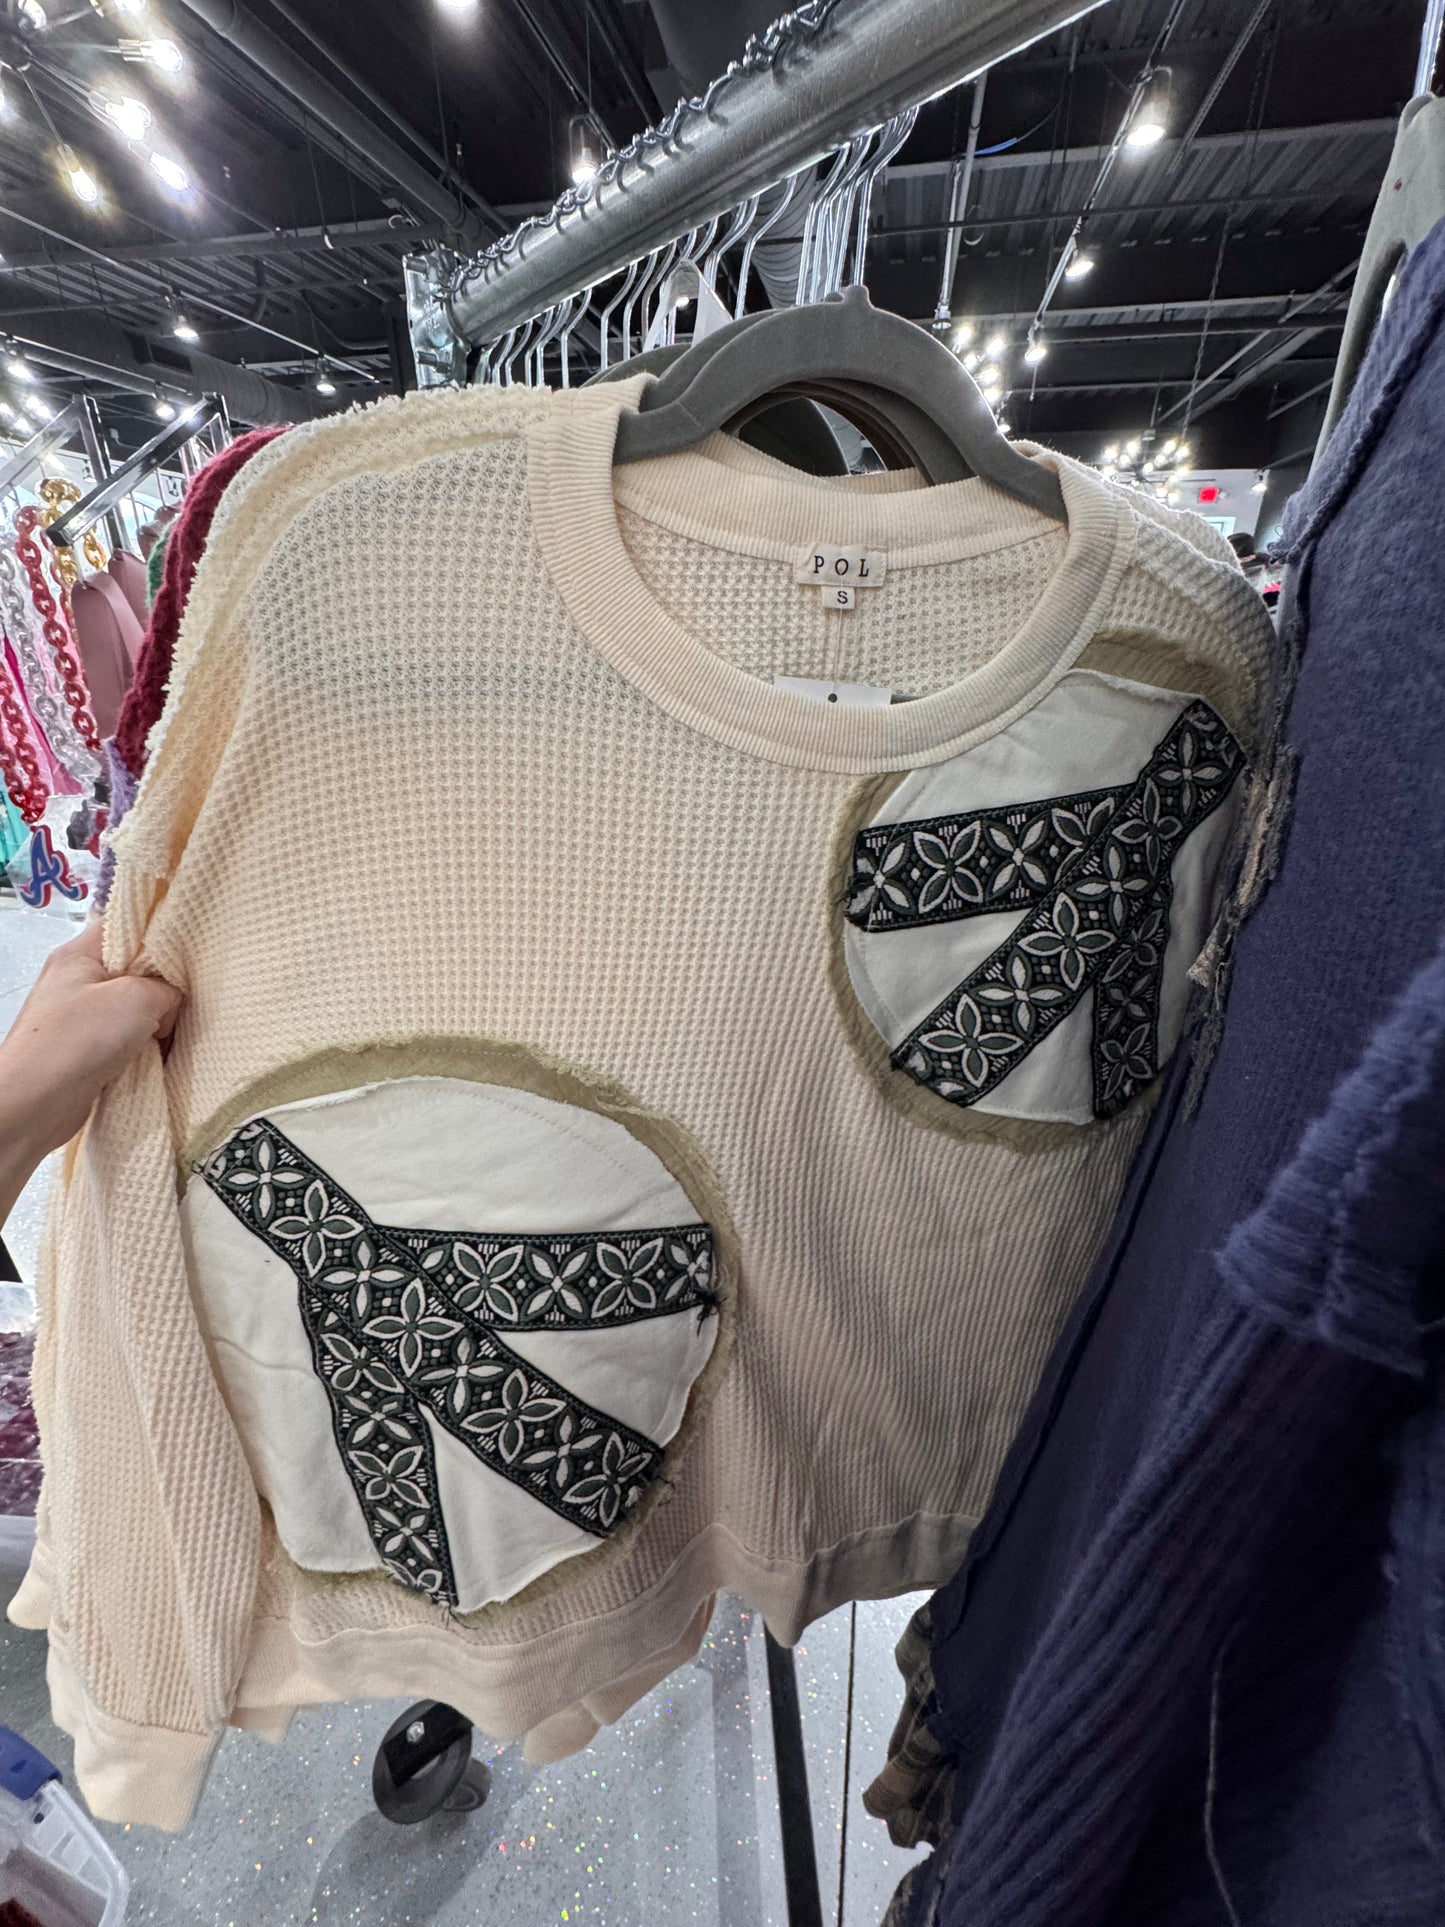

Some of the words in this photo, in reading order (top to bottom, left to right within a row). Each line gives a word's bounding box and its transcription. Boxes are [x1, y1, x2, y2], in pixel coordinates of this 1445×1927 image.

[813, 555, 870, 577] POL
[837, 590, 848, 604] S
[20, 825, 88, 909] A
